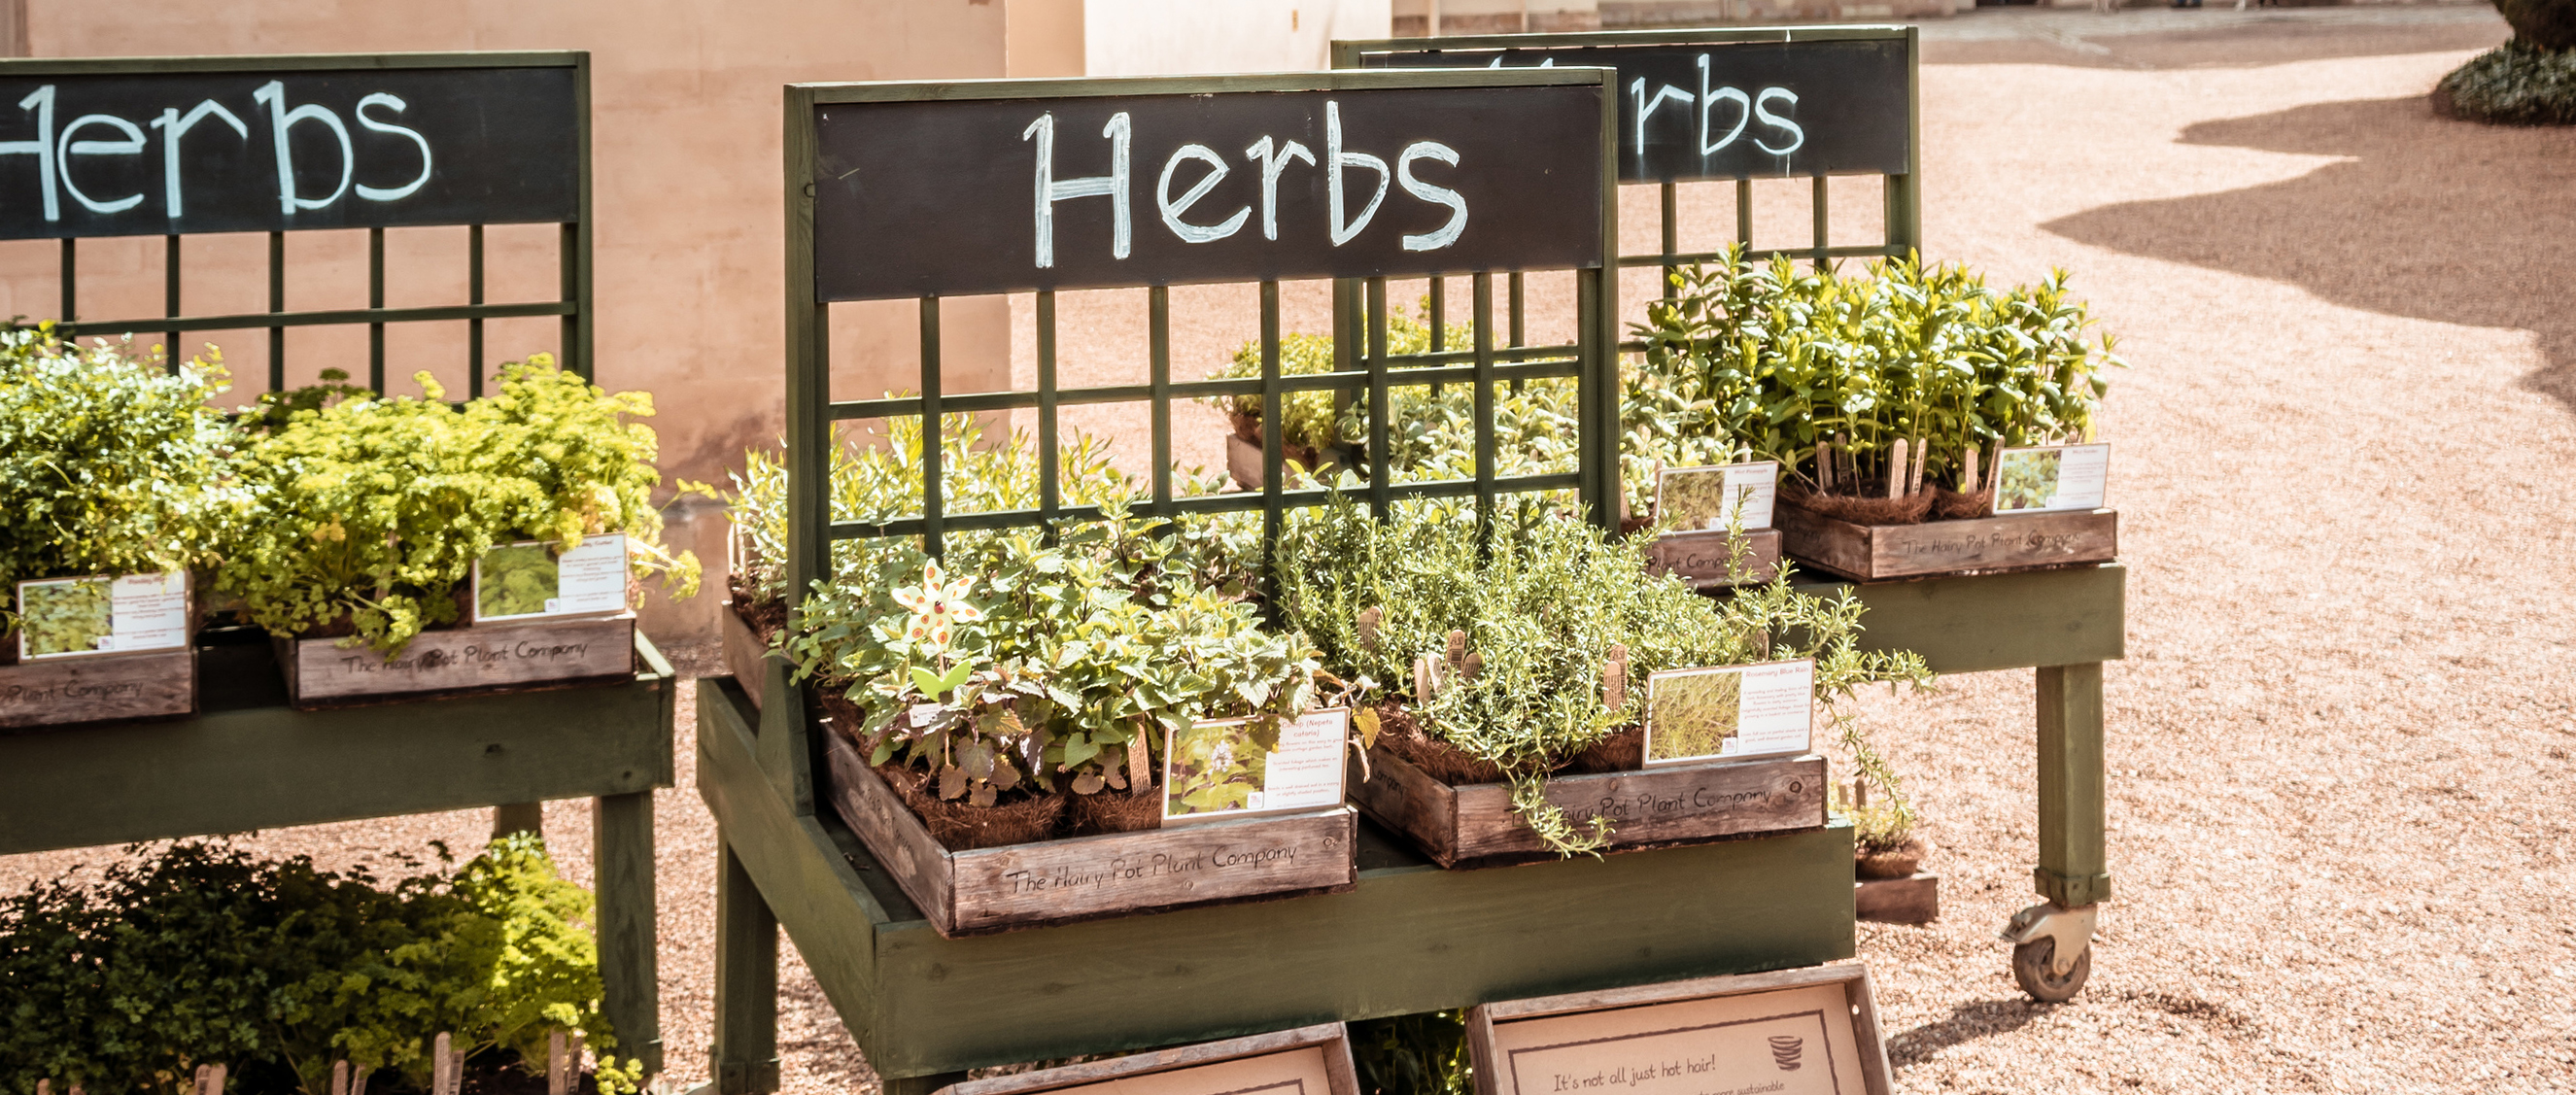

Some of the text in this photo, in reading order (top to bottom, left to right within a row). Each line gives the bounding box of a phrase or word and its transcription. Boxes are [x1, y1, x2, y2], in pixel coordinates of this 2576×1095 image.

[1022, 100, 1468, 268] Herbs
[1931, 539, 1961, 554] Hairy
[1966, 535, 1986, 549] Pot
[1646, 557, 1681, 571] Plant
[341, 655, 376, 673] The
[464, 645, 509, 664] Plant
[515, 641, 588, 662] Company
[1745, 670, 1778, 679] Rosemary
[64, 679, 143, 700] Company
[1306, 718, 1333, 728] (Nepeta
[1600, 797, 1630, 818] Pot
[1638, 792, 1685, 812] Plant
[1694, 787, 1771, 810] Company
[1006, 846, 1297, 894] The Hairy Pot Plant Company
[1553, 1054, 1716, 1092] It's not all just hot hair!
[1737, 1080, 1785, 1095] sustainable
